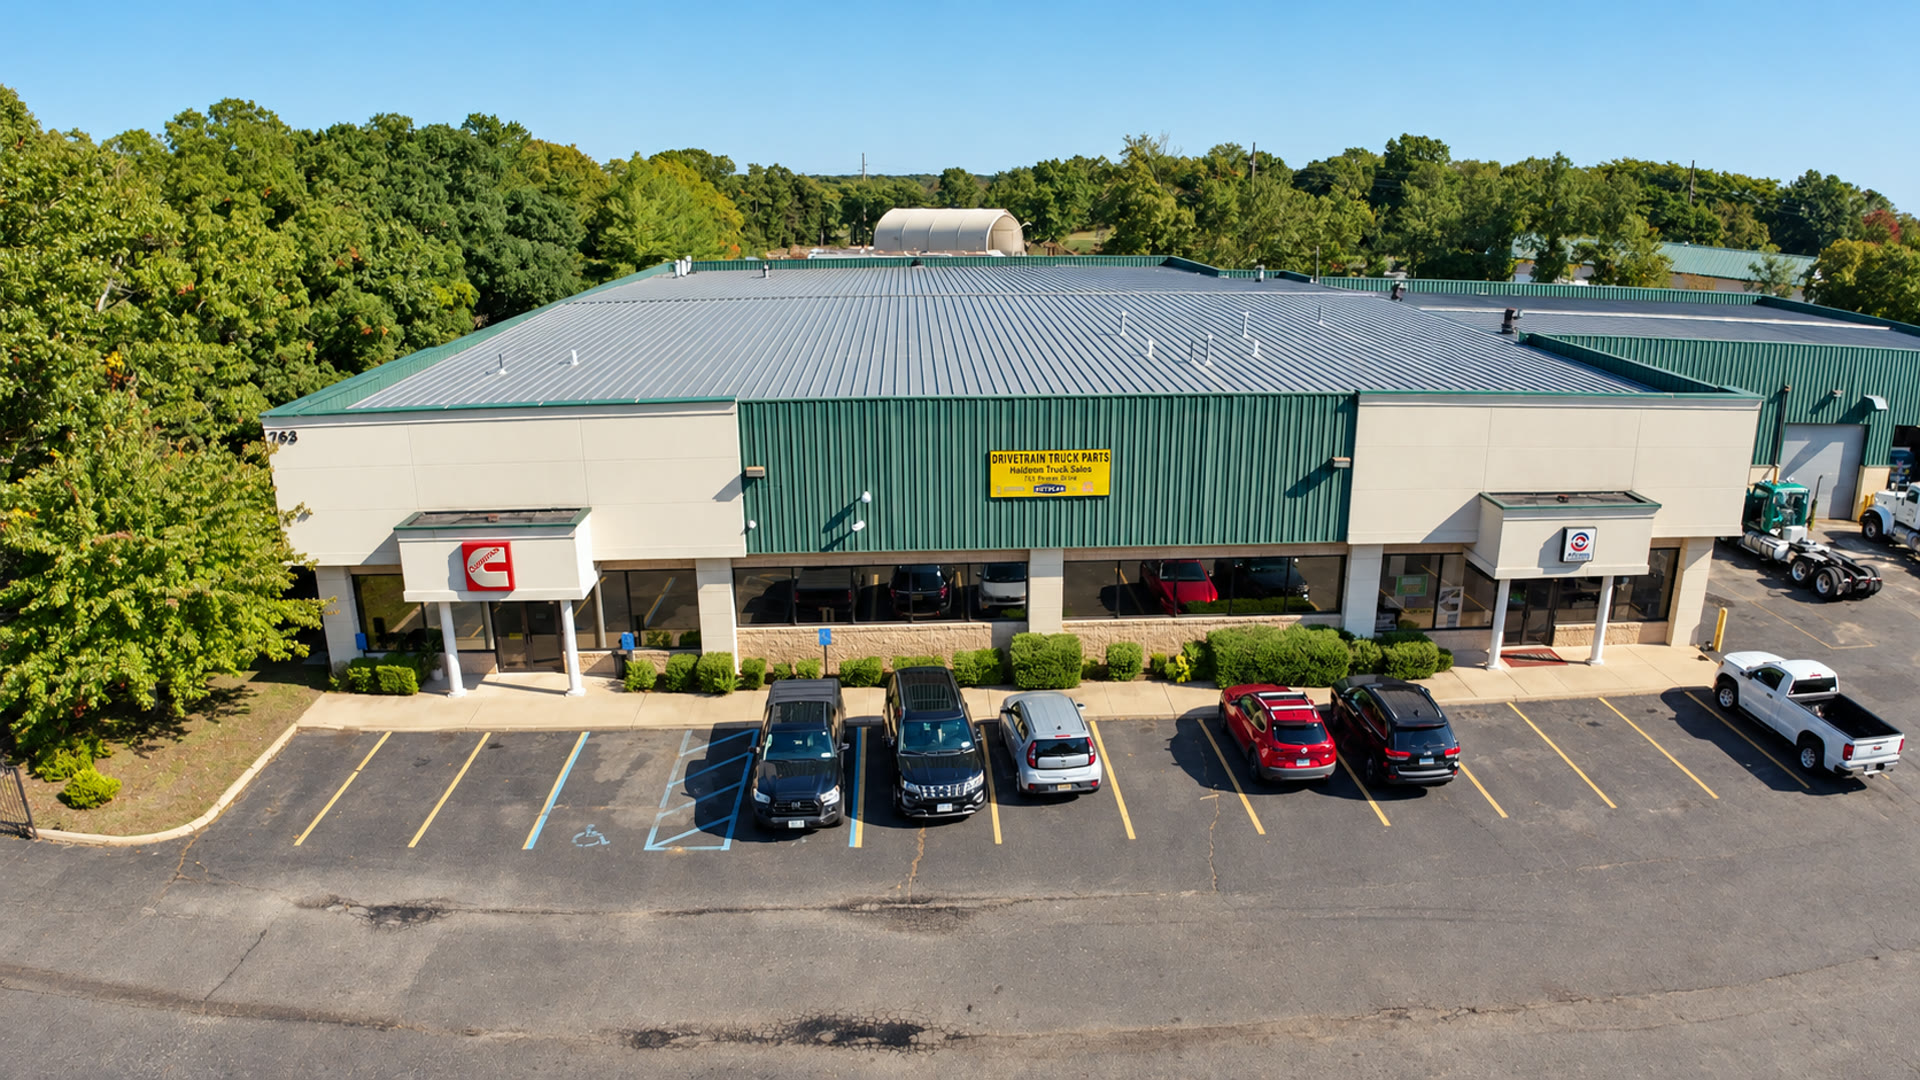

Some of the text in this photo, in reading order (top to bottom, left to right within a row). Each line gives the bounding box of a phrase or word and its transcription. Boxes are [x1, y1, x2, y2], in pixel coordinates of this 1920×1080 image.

[268, 430, 298, 445] 763
[992, 452, 1110, 464] DRIVETRAIN TRUCK PARTS
[1046, 465, 1069, 473] Truck
[1070, 464, 1092, 473] Sales
